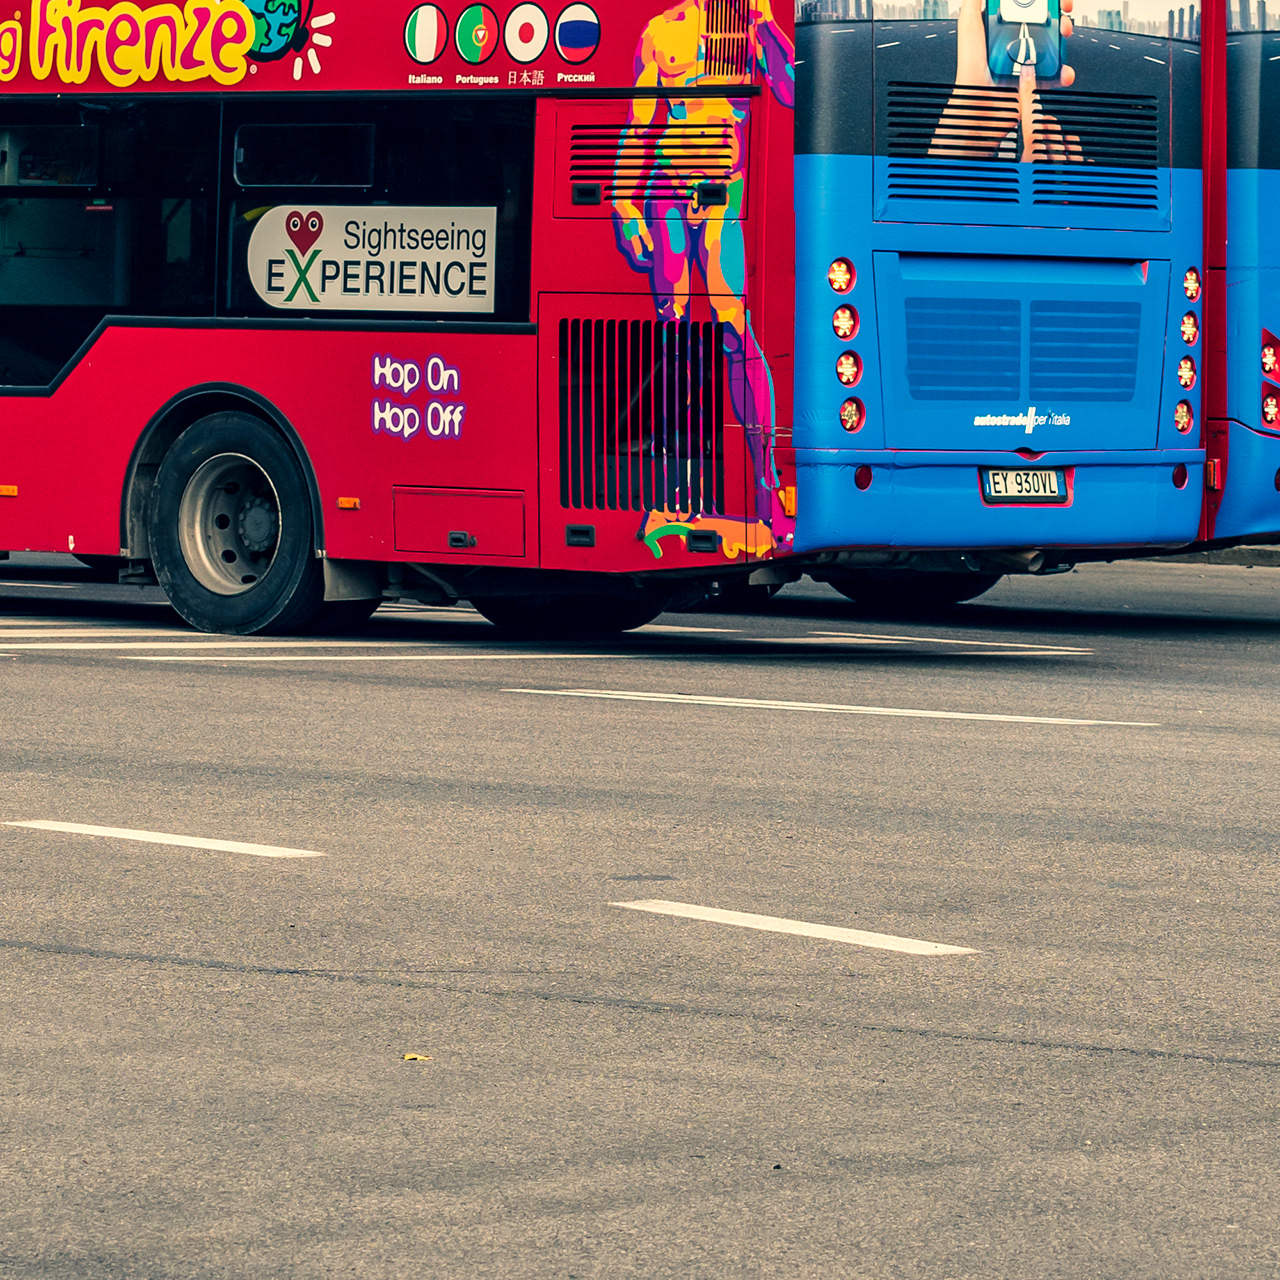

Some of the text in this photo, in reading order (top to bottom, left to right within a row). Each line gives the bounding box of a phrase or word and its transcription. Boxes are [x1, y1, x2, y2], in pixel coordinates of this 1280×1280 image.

[408, 74, 443, 84] Italiano
[455, 74, 499, 86] Portugues
[507, 70, 544, 86] 日本語
[557, 72, 595, 84] Русский
[343, 220, 487, 259] Sightseeing
[267, 249, 488, 303] EXPERIENCE
[373, 356, 460, 394] Hop On
[373, 401, 465, 439] Hop Off
[974, 413, 1027, 426] autostrade
[992, 472, 1008, 494] EY
[1015, 472, 1056, 494] 930VL
